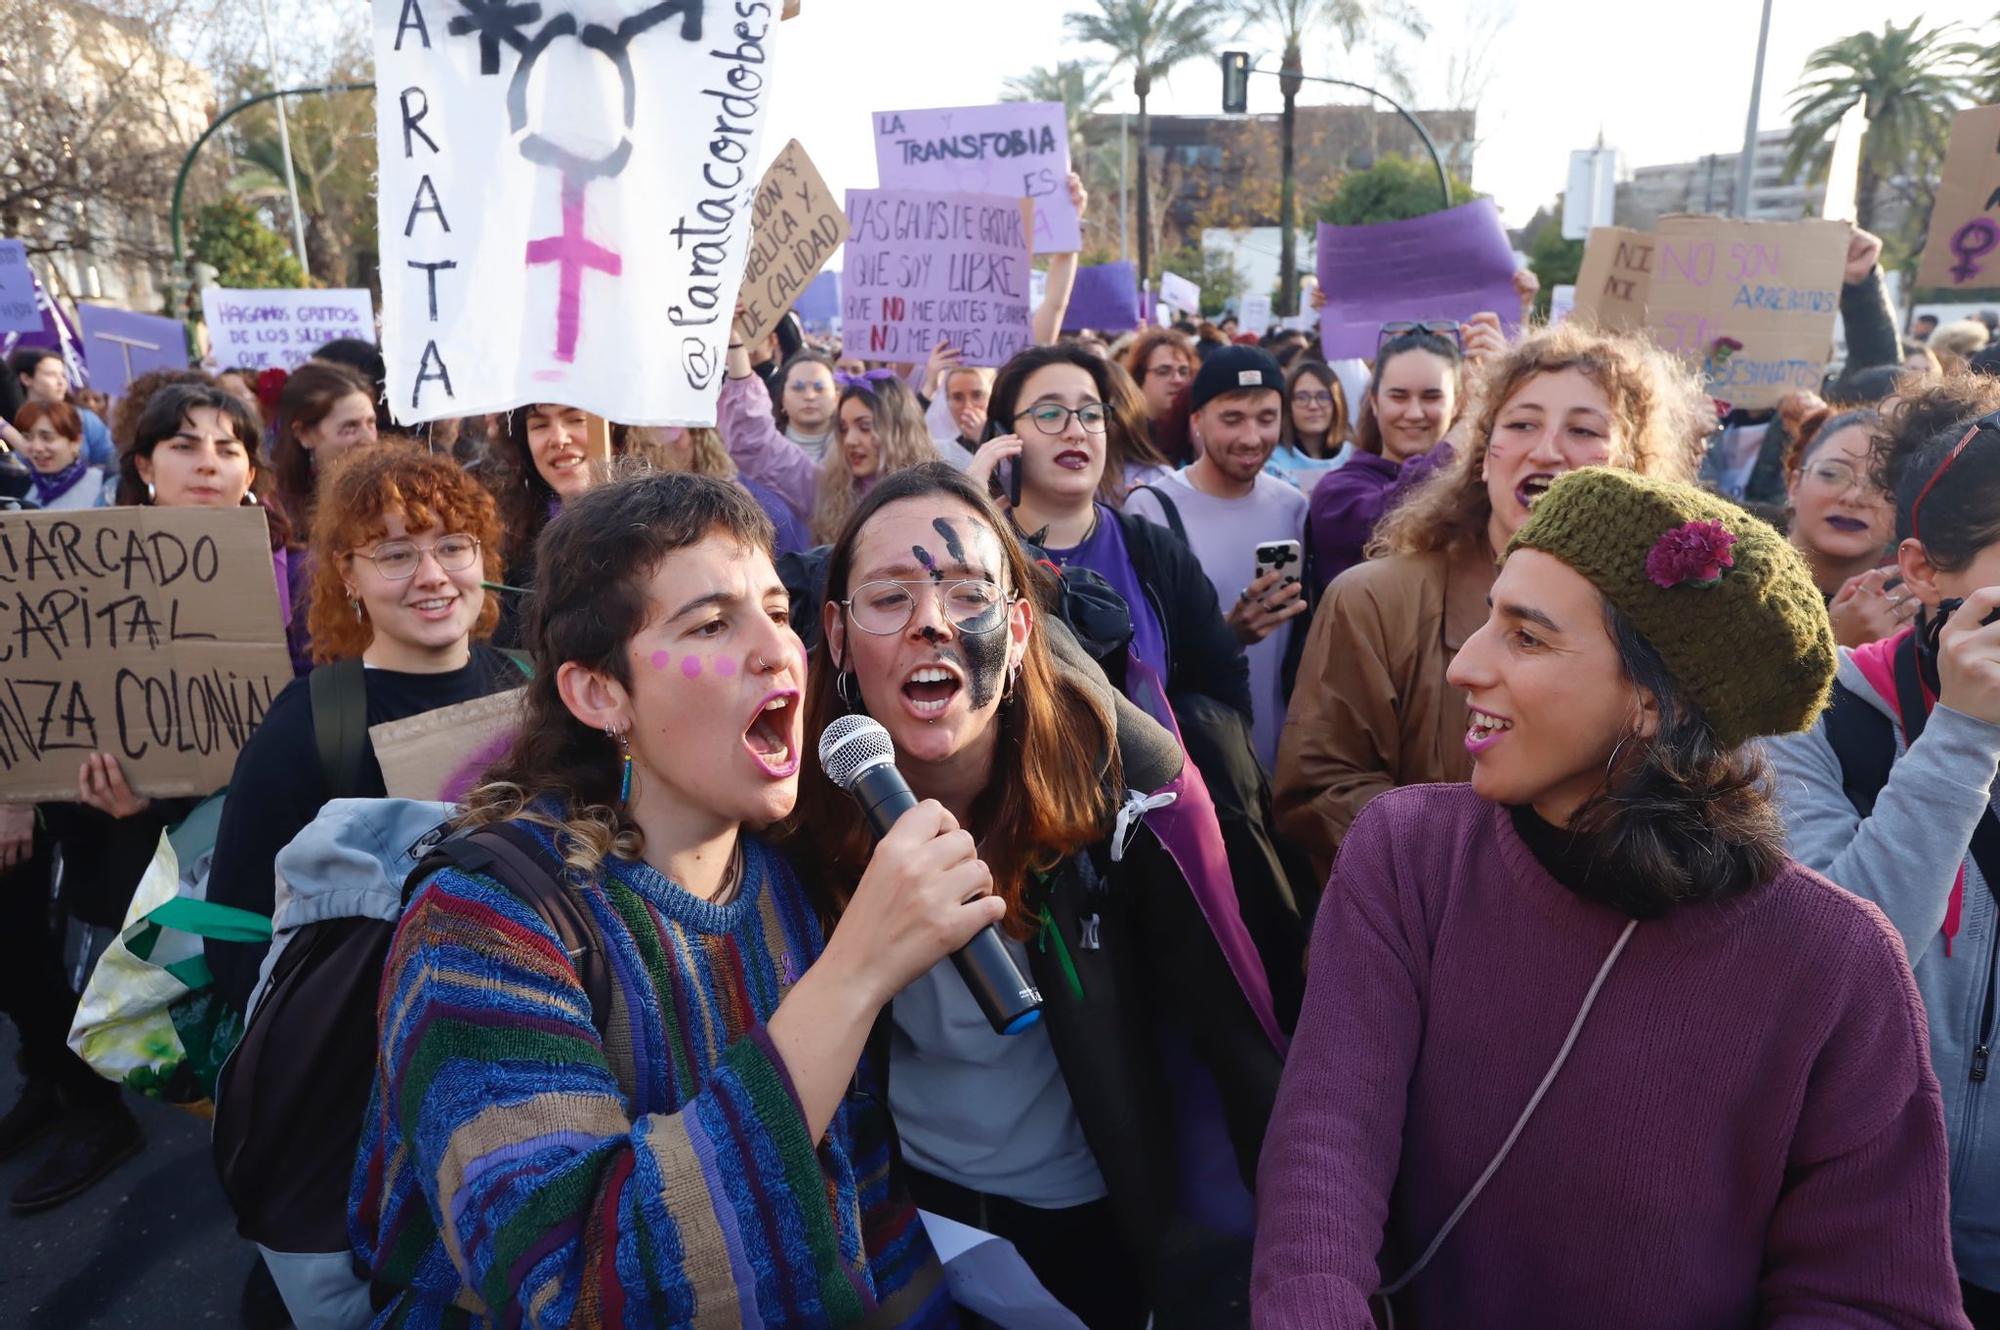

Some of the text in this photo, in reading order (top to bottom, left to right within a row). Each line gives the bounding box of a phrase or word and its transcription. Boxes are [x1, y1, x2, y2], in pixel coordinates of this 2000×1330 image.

[880, 115, 905, 135] LA
[896, 124, 1056, 165] TRANSFOBIA
[796, 181, 811, 213] Y
[1023, 168, 1058, 197] ES
[848, 198, 890, 244] LAS
[853, 251, 1020, 298] QUE SOY LIBRE
[1660, 240, 1781, 287] NO SON
[740, 300, 767, 338] DE
[883, 296, 905, 321] NO
[911, 300, 935, 322] ME
[230, 330, 249, 344] DE
[256, 329, 289, 343] LOS
[870, 324, 898, 354] NO
[908, 328, 931, 353] ME
